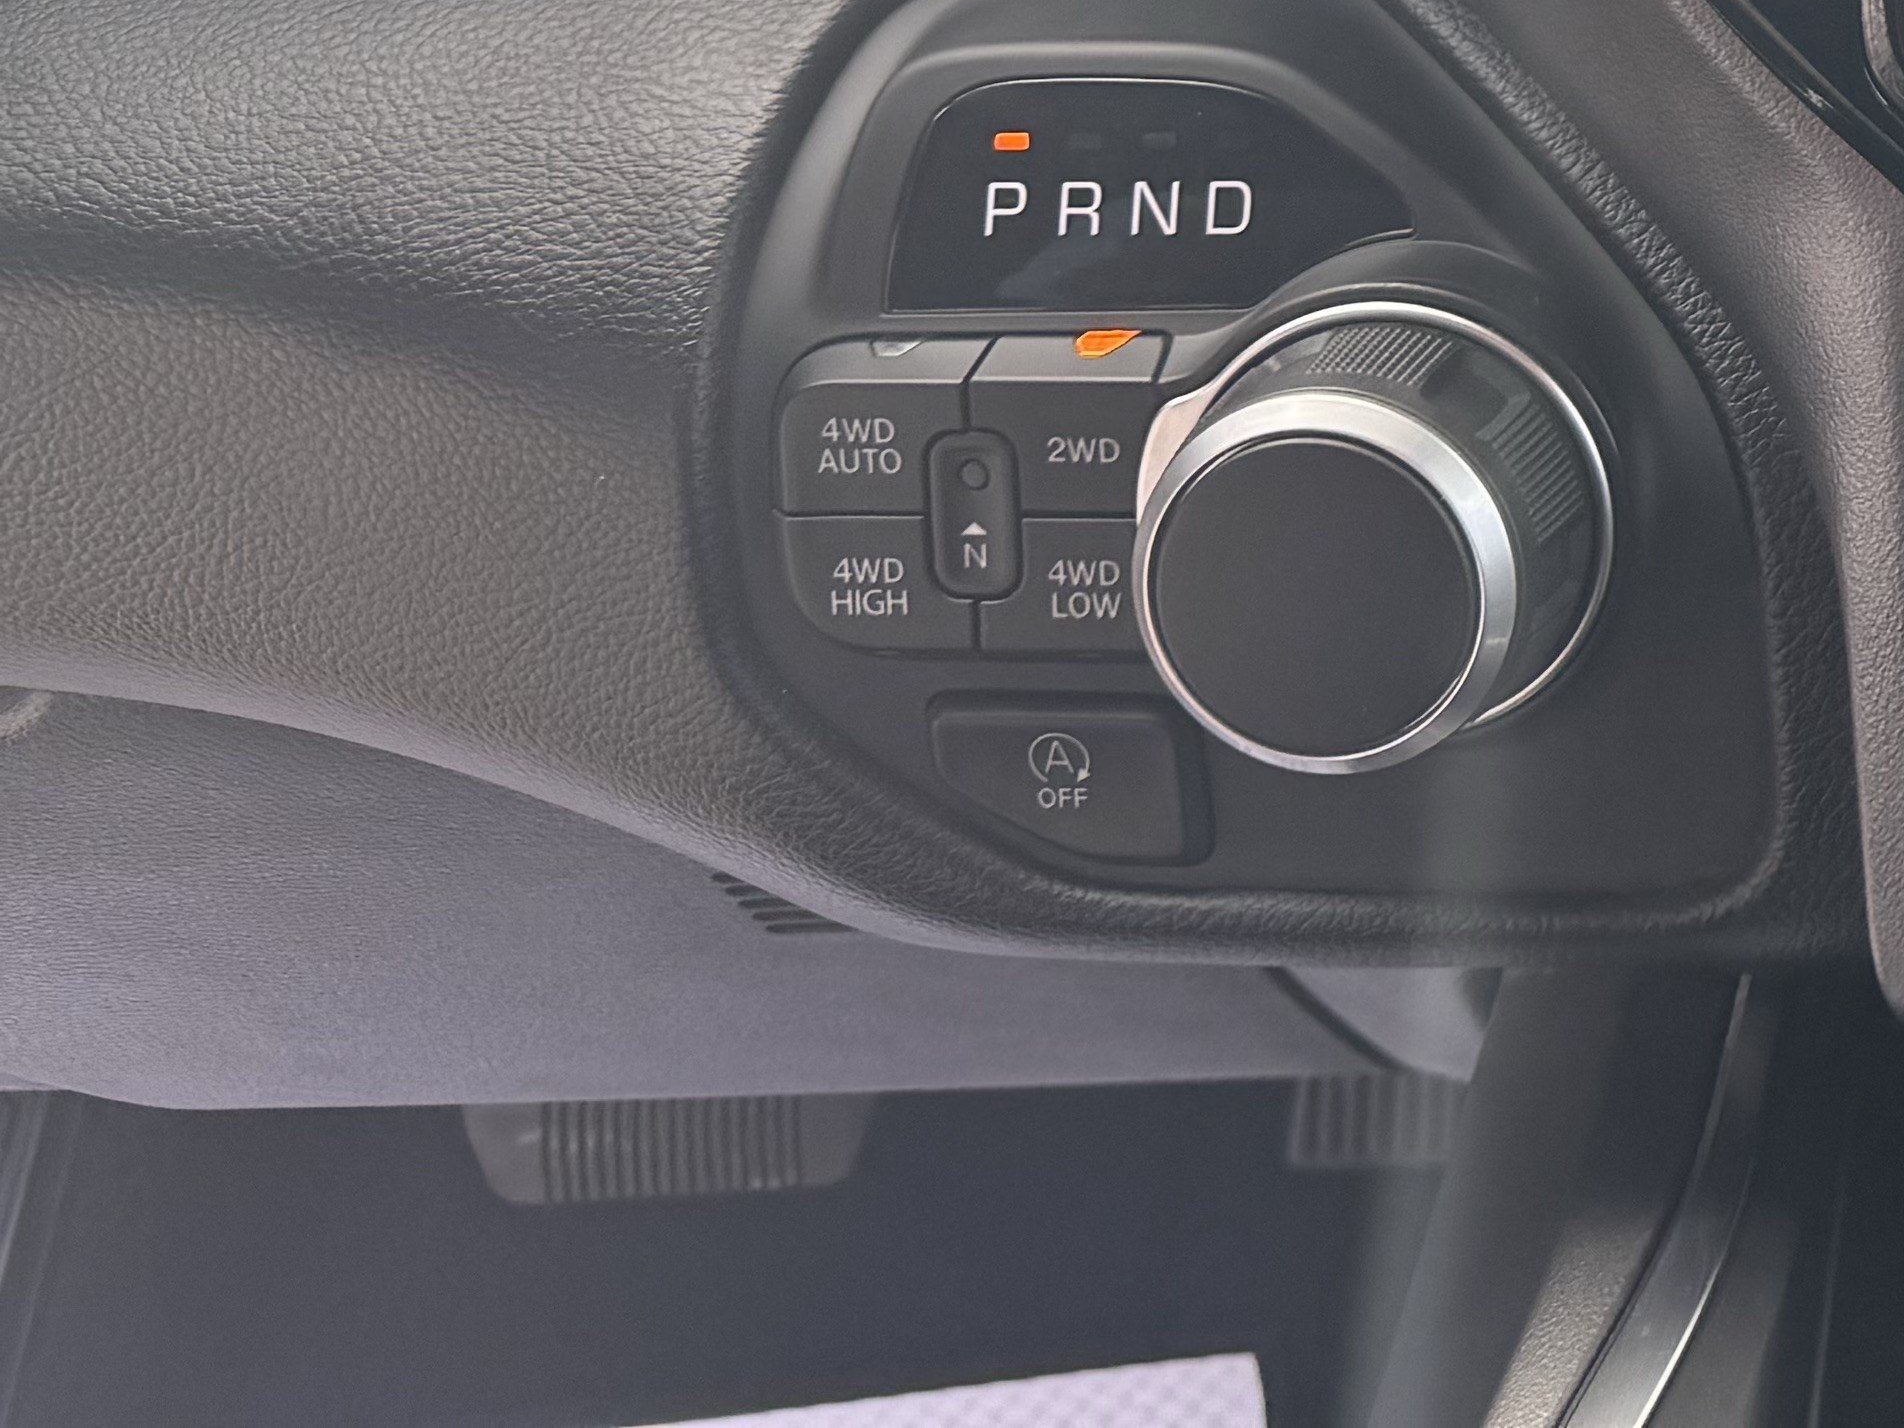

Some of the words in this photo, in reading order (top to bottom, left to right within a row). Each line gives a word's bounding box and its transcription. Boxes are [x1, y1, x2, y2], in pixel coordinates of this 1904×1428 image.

[984, 181, 1027, 237] P
[1057, 180, 1102, 236] R
[1130, 180, 1181, 236] N
[1205, 179, 1253, 235] D
[821, 417, 895, 443] 4WD
[818, 449, 902, 475] AUTO
[1046, 438, 1120, 463] 2WD
[962, 545, 988, 569] N
[832, 559, 904, 585] 4WD
[1047, 560, 1120, 586] 4WD
[830, 590, 909, 615] HIGH
[1049, 591, 1121, 618] LOW
[1036, 788, 1088, 807] OFF
